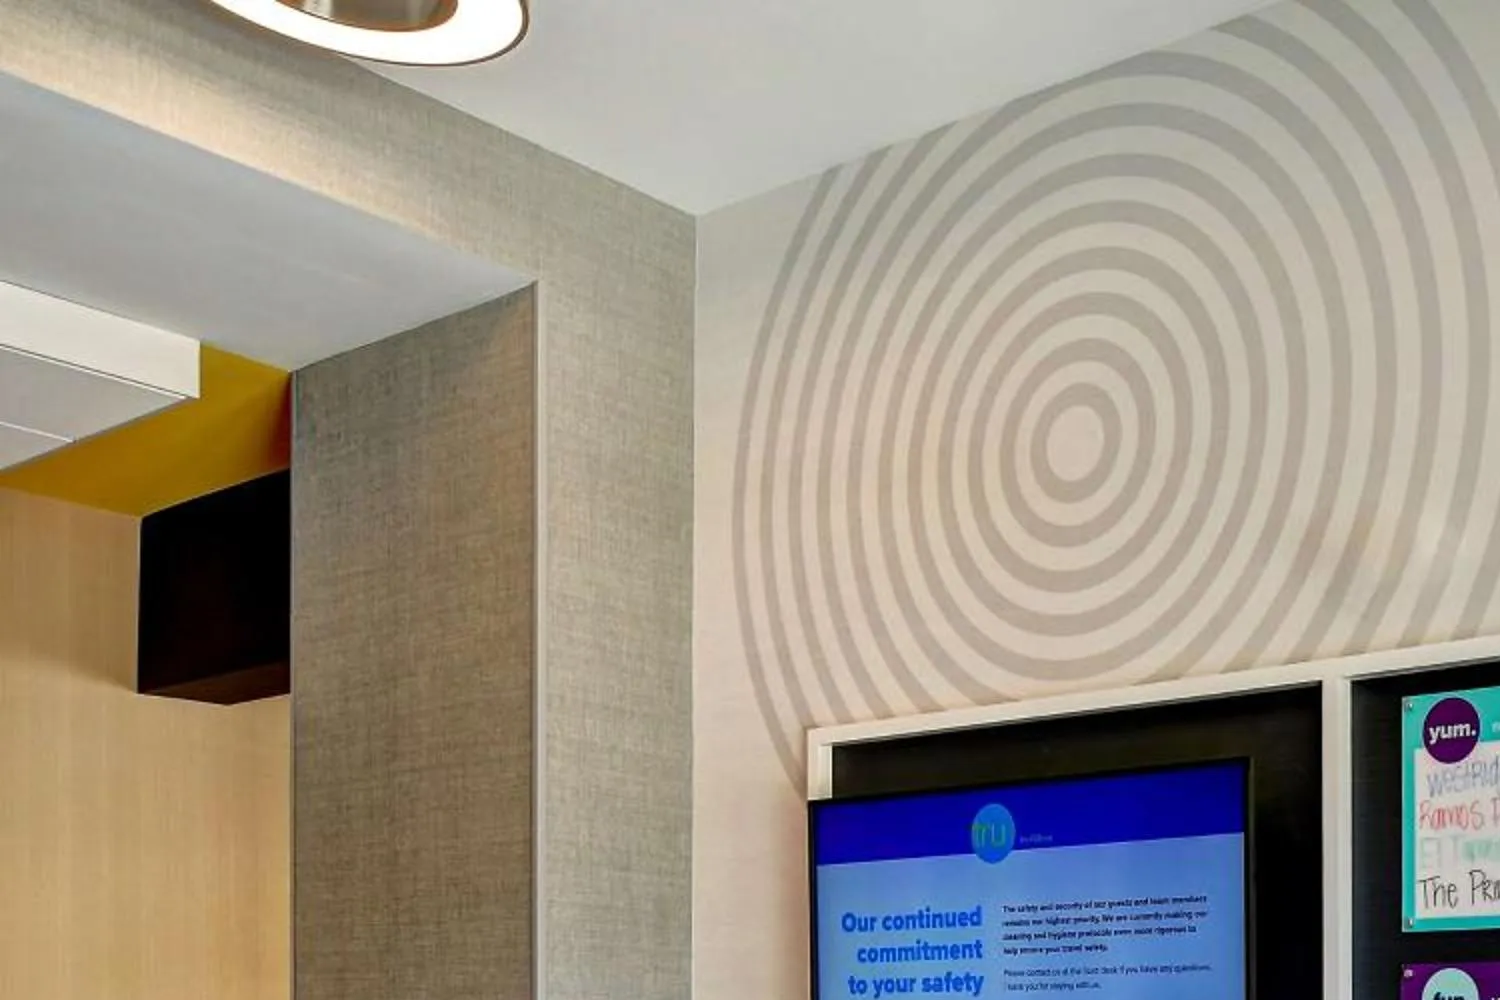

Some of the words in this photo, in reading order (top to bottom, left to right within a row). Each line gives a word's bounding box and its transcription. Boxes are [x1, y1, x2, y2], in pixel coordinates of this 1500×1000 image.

[1429, 722, 1476, 744] yum.
[1419, 875, 1459, 910] The
[842, 911, 876, 932] Our
[882, 906, 982, 930] continued
[857, 940, 983, 963] commitment
[848, 977, 867, 995] to
[873, 979, 917, 999] your
[922, 971, 984, 997] safety
